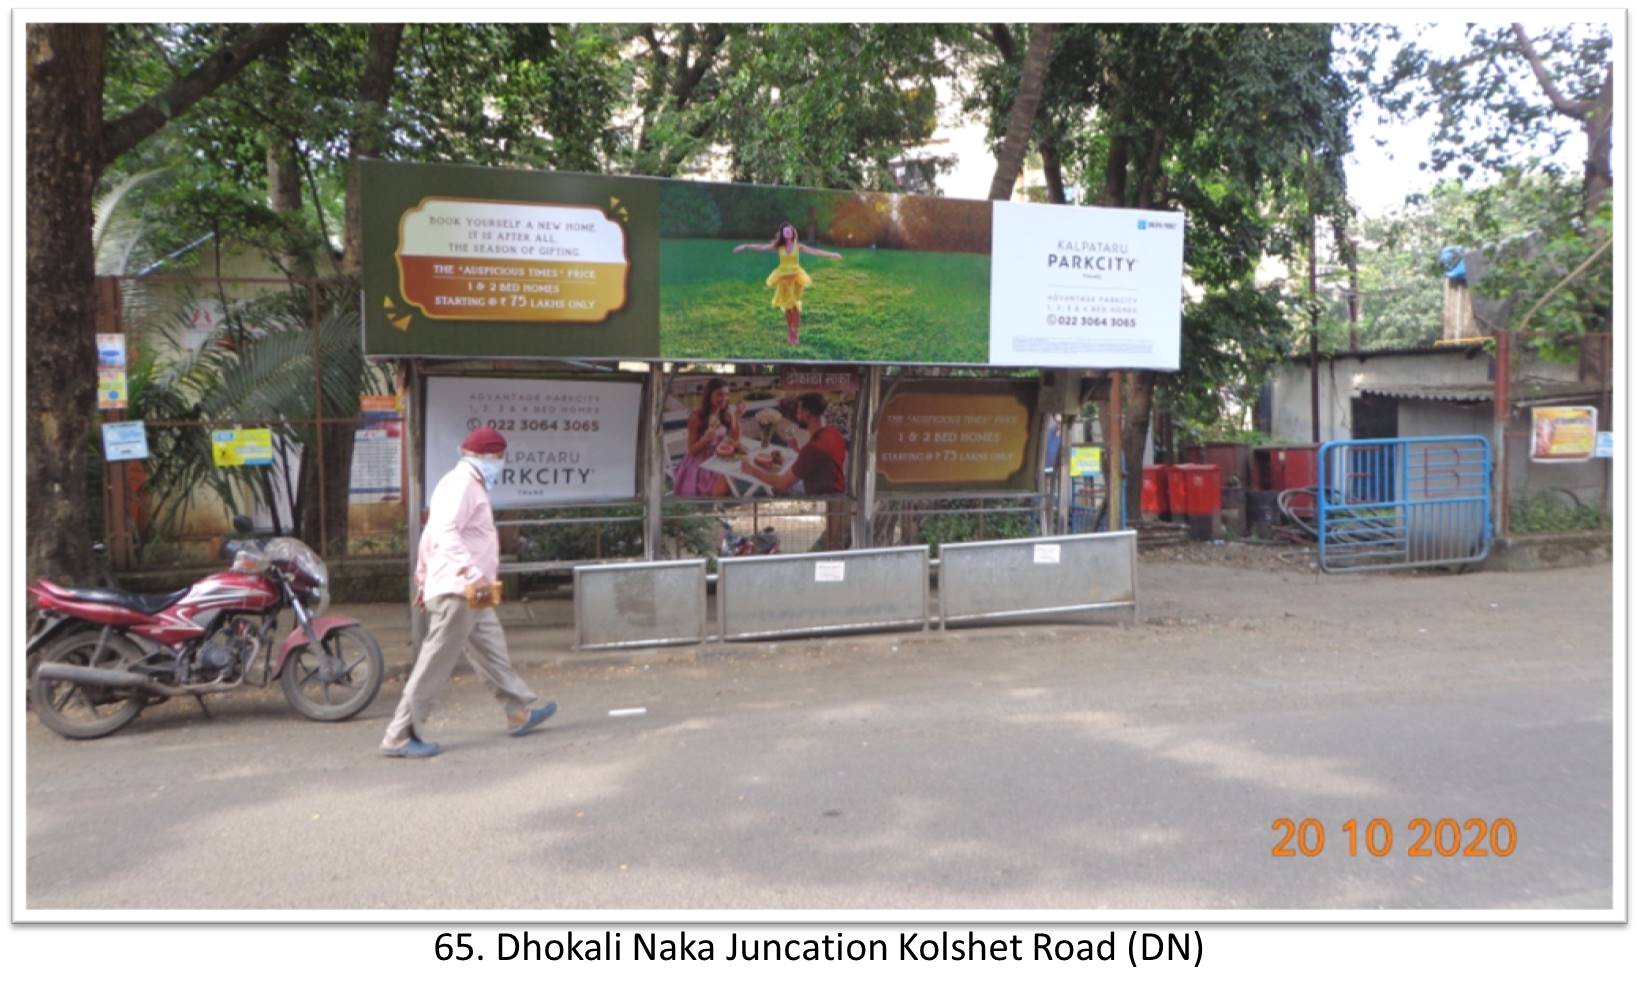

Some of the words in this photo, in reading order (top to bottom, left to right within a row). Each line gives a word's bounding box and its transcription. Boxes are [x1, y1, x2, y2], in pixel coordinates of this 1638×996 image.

[429, 216, 460, 226] BOOK
[467, 219, 520, 229] YOURSELF
[526, 222, 534, 230] A
[538, 223, 561, 231] NEW
[468, 231, 478, 241] IT
[482, 232, 492, 241] IS
[499, 232, 530, 242] AFTER
[449, 244, 469, 253] THE
[473, 245, 518, 255] SEASON
[522, 247, 535, 256] OF
[1057, 240, 1129, 255] KALPATARU
[1047, 253, 1137, 272] PARKCITY
[433, 264, 454, 275] THE
[567, 270, 596, 280] PRICE
[489, 283, 497, 292] 2
[499, 284, 520, 293] BED
[523, 285, 560, 294] HOMES
[435, 296, 485, 307] STARTING
[510, 296, 527, 308] 75
[530, 300, 565, 309] LAKHS
[568, 300, 595, 310] ONLY
[1058, 315, 1078, 327] 022
[1081, 317, 1108, 328] 3064
[1111, 318, 1137, 329] 3065
[469, 393, 542, 402] ADVANTAGE
[545, 394, 600, 403] PARKCITY
[534, 405, 557, 414] BED
[560, 406, 600, 414] HOMES
[486, 418, 516, 432] 022
[520, 419, 558, 432] 3064
[563, 420, 600, 432] 3065
[923, 432, 931, 442] 2
[934, 432, 958, 442] BED
[960, 432, 1000, 442] HOMES
